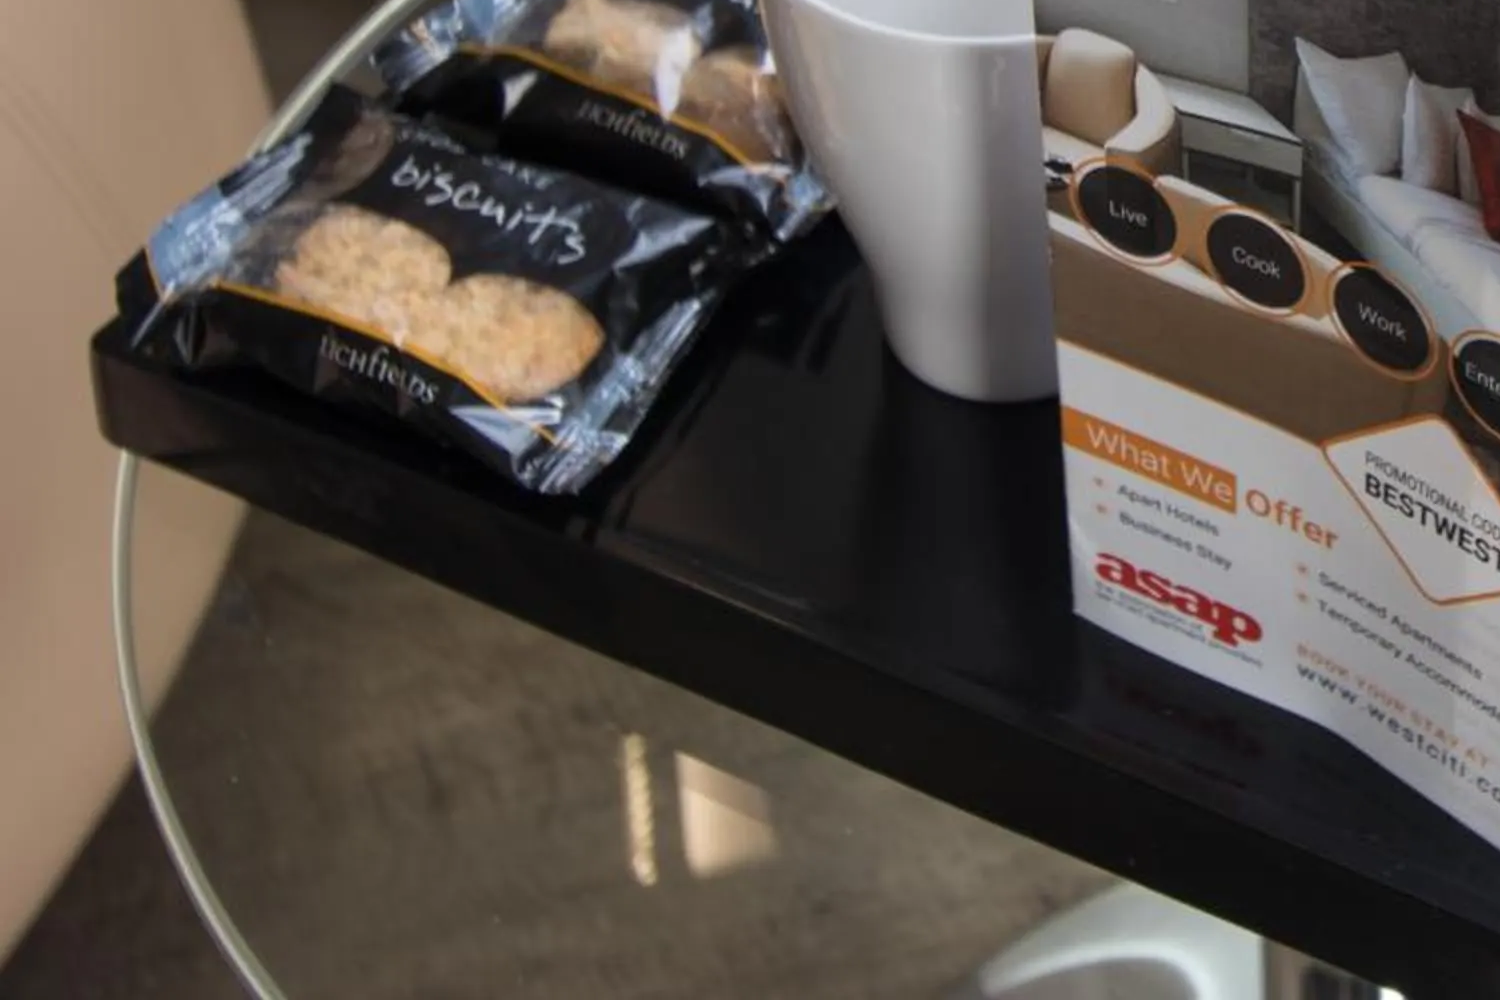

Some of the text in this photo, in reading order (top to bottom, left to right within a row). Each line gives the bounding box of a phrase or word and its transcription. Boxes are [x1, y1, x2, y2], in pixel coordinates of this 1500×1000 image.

[391, 154, 587, 264] biscuits
[1108, 199, 1148, 228] Live
[1232, 245, 1281, 281] Cook
[1357, 301, 1407, 342] Work
[1086, 421, 1340, 549] What We Offer
[1117, 484, 1220, 537] Apart Hotels
[1364, 450, 1468, 522] PROMOTIONAL
[1118, 511, 1233, 571] Business Stay
[1094, 551, 1263, 648] asap
[1317, 599, 1401, 659] Temporary
[1318, 571, 1483, 681] Serviced Apartments
